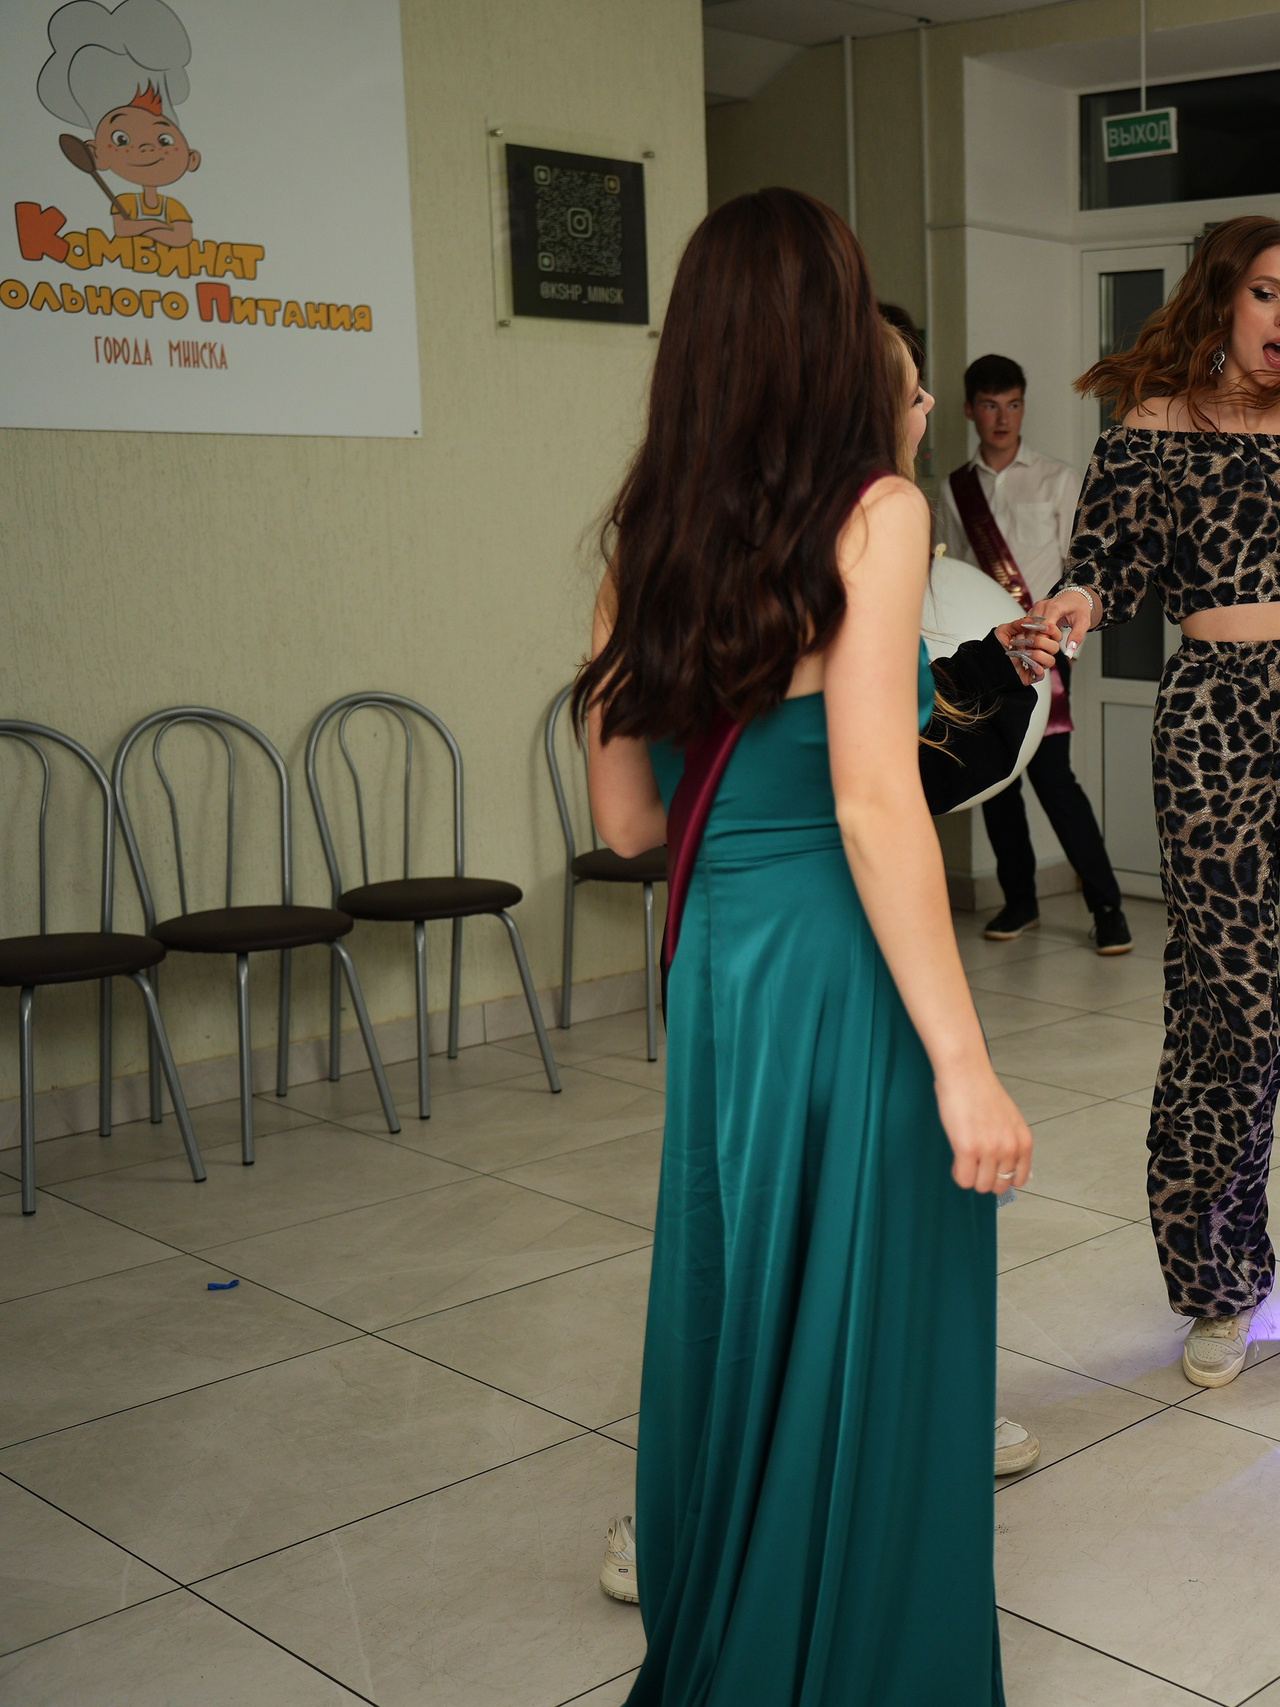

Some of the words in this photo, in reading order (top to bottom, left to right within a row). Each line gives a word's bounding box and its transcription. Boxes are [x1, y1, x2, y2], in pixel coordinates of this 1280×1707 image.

[1108, 121, 1170, 148] ВЫХОД
[94, 336, 153, 366] ГОРОДА
[169, 339, 228, 370] МИНСКА
